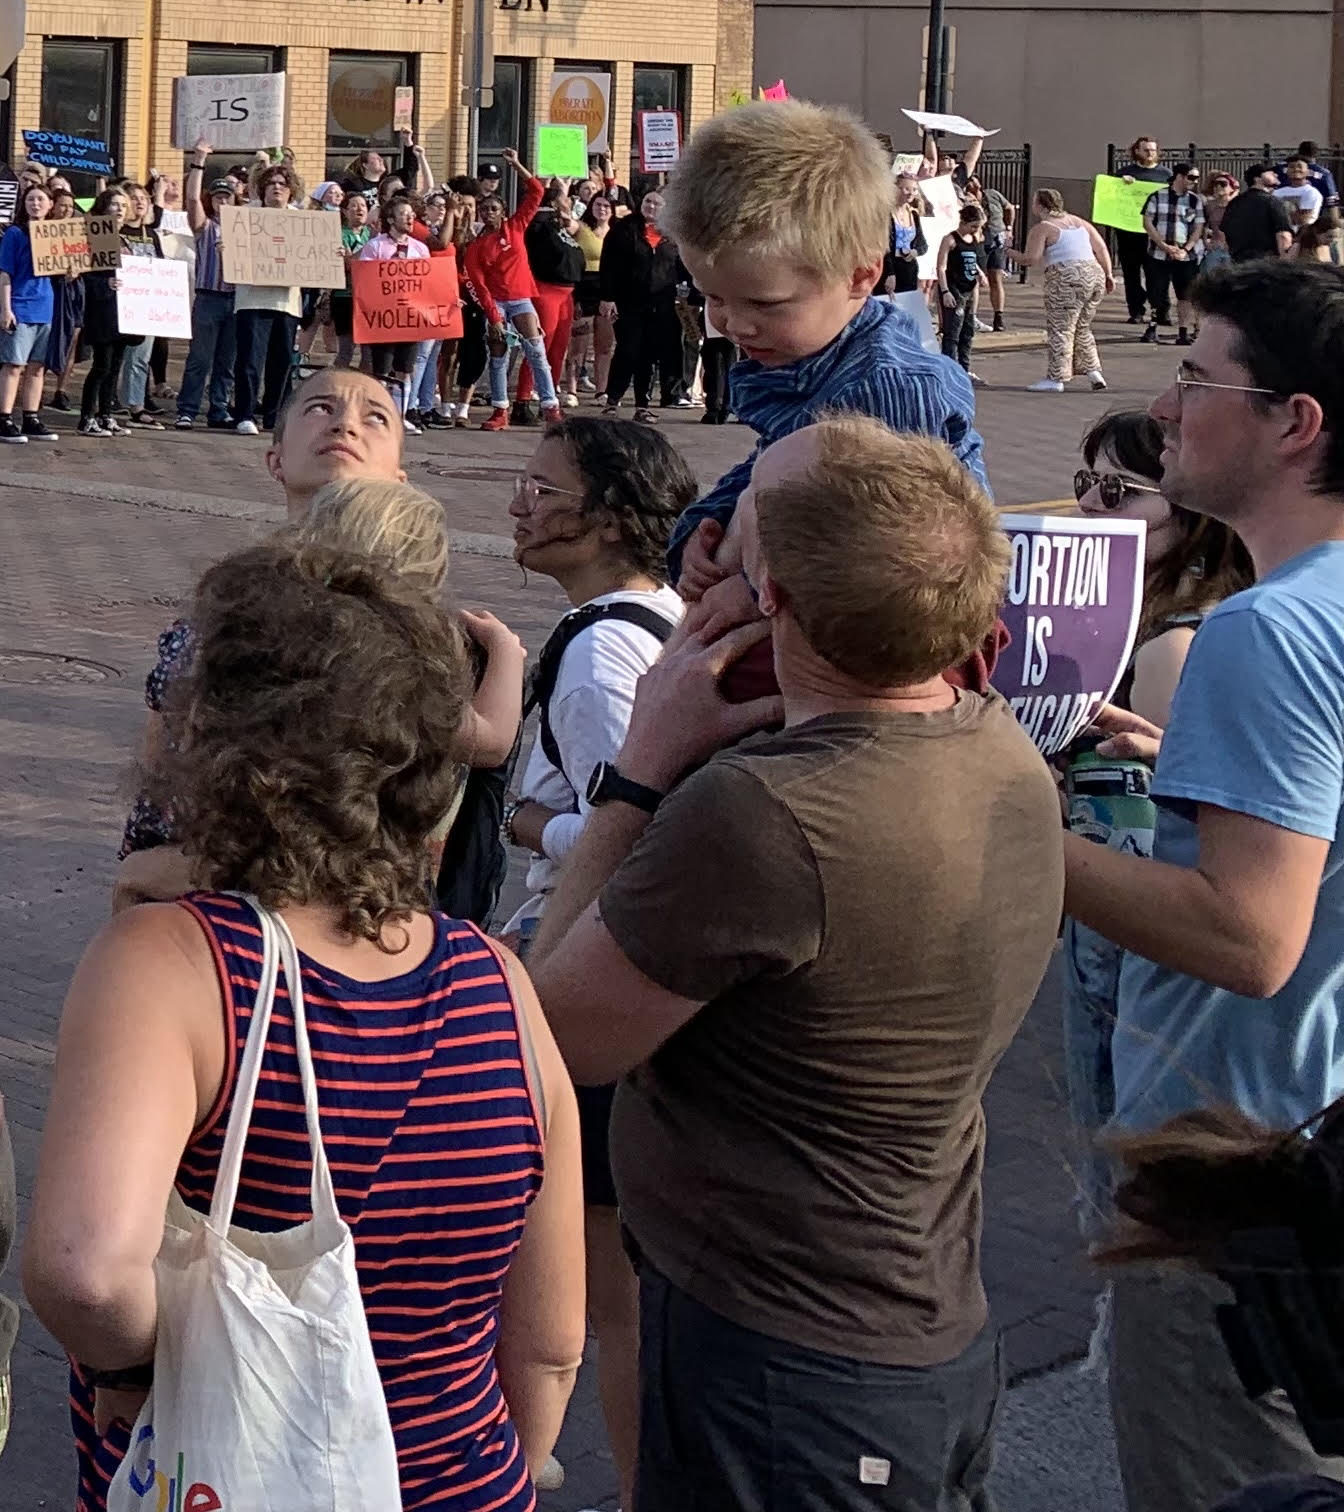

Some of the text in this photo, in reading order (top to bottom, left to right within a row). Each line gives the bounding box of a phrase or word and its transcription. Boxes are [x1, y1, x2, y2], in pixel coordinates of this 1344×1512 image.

[208, 97, 249, 122] IS
[24, 130, 106, 153] DO YOU WANT
[34, 141, 89, 156] TO PAY
[29, 152, 113, 174] CHILD SUPPORT
[34, 220, 114, 238] ABORTION
[232, 210, 337, 237] ABORTION
[37, 251, 117, 273] HEALTHCARE
[294, 261, 339, 282] RIGHT
[378, 260, 432, 278] FORCED
[381, 279, 423, 296] BIRTH
[362, 304, 449, 330] VIOLENCE
[1008, 532, 1111, 607] ORTION
[1021, 615, 1053, 687] IS
[1008, 690, 1104, 755] THCARE
